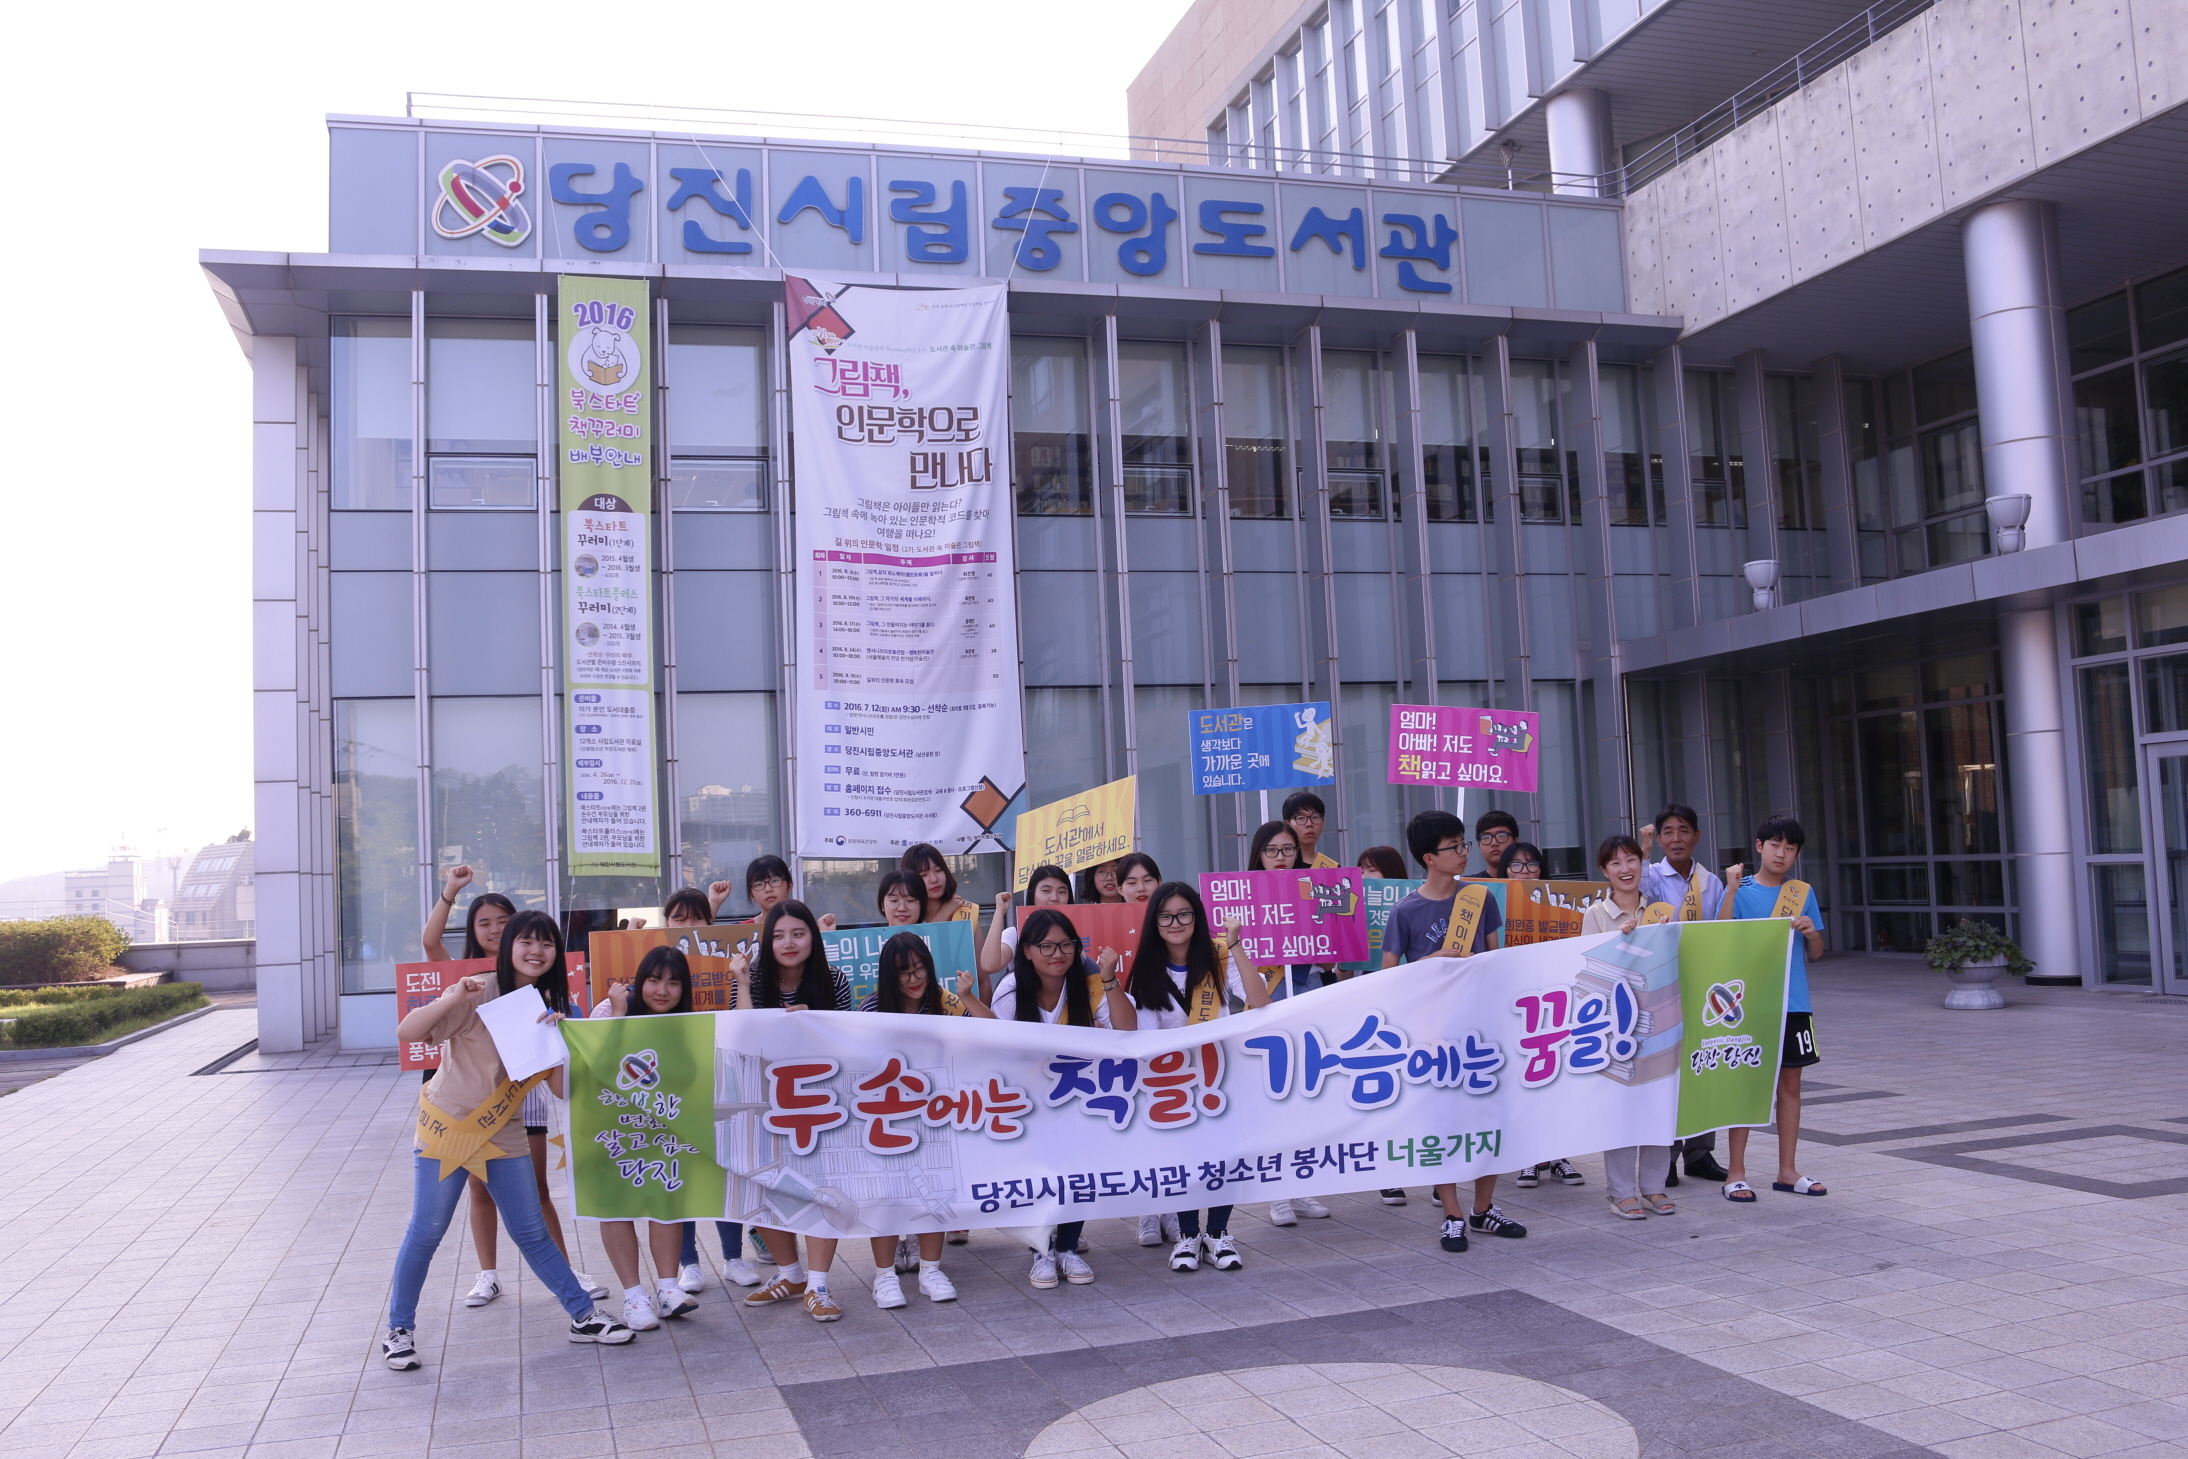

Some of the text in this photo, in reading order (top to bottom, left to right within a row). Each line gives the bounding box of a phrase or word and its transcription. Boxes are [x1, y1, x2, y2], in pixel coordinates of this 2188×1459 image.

[548, 161, 1458, 293] 당진시립중앙도서관
[572, 301, 636, 332] 2016
[814, 357, 910, 399] 그림책,
[570, 388, 639, 413] 북스타트
[568, 415, 640, 438] 책꾸러미
[836, 404, 982, 444] 인문학으로
[569, 444, 641, 467] 배부안내
[910, 447, 993, 490] 만나다
[594, 497, 617, 510] 대상
[857, 497, 963, 512] 그림책은 아이들만 읽는다?
[583, 518, 629, 533] 북스타트
[823, 507, 990, 526] 그림책 속에 녹아 있는 인문학적 코드를 찾아
[876, 527, 936, 539] 여행을 떠나요!
[835, 538, 842, 547] 길
[844, 538, 859, 548] 위의
[861, 540, 883, 550] 인문학
[885, 542, 900, 553] 일정
[601, 554, 634, 563] 2015. 4월생
[625, 564, 641, 573] 3월생
[576, 586, 639, 601] 북스타트플러스
[620, 623, 635, 631] 4월생
[626, 633, 641, 641] 3월생
[844, 702, 863, 711] 2016.
[872, 704, 890, 712] 12(화)
[927, 703, 949, 713] 선착순
[844, 725, 875, 736] 일반시민
[1200, 713, 1253, 734] 도서관은
[1400, 710, 1437, 730] 엄마!
[845, 745, 914, 758] 당진시립중앙도서관
[1200, 737, 1242, 752] 생각보다
[1398, 733, 1473, 754] 아빠! 저도
[845, 766, 860, 776] 무료
[1201, 752, 1270, 772] 가까운 곳에
[1398, 754, 1508, 784] 책읽고 싶어요.
[845, 783, 875, 795] 홈페이지
[876, 785, 892, 795] 접수
[1202, 773, 1245, 788] 있습니다.
[845, 807, 882, 818] 360-6911
[1044, 821, 1105, 856] 도서관에서
[1076, 834, 1130, 864] 열람하세요.
[1210, 878, 1252, 902] 엄마!
[1362, 885, 1400, 907] 늘의
[1261, 903, 1295, 926] 저도
[1538, 919, 1584, 935] 발급받으
[1217, 932, 1276, 960] 읽고
[1281, 934, 1338, 958] 싶어요.
[405, 971, 442, 993] 도전!
[1726, 1035, 1751, 1044] Dangjin
[1796, 1029, 1814, 1056] 19
[768, 982, 1636, 1151] 두 손에는 책을! 가슴에는 꿈을!
[1691, 1046, 1761, 1074] 당찬 당진
[595, 1130, 650, 1158] 살고
[617, 1158, 684, 1191] 당진
[971, 1129, 1502, 1214] 당진시립도서관 청소년 봉사단 너울가지
